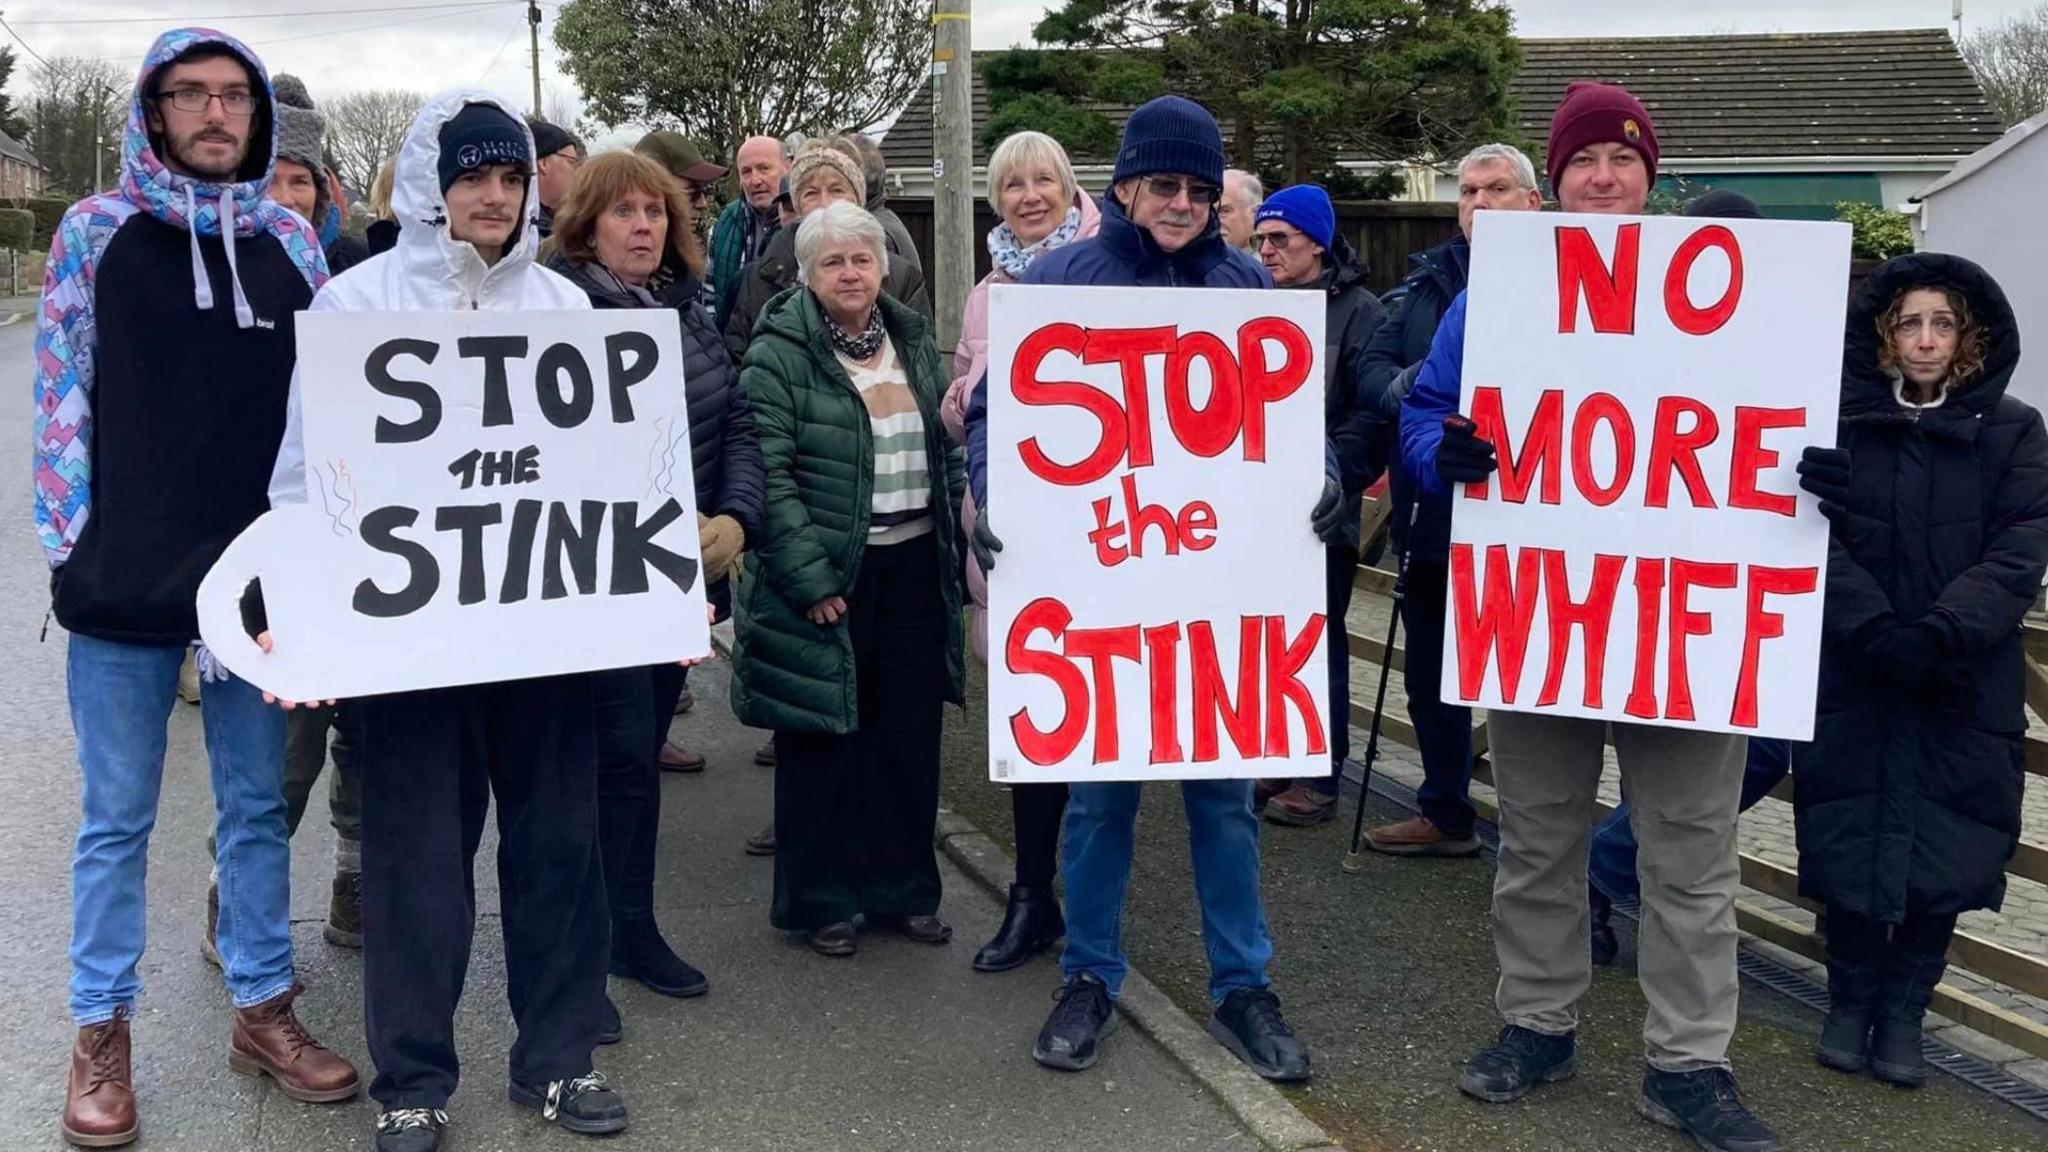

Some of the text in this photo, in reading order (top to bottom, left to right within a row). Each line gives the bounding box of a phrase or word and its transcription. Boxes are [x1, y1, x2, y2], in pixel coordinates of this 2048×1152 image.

[1555, 224, 1743, 336] NO
[365, 331, 659, 443] STOP
[1010, 316, 1313, 486] STOP
[448, 446, 541, 489] THE
[1463, 387, 1806, 517] MORE
[353, 498, 698, 617] STINK
[1088, 473, 1218, 567] the
[1005, 597, 1328, 766] STINK
[1450, 543, 1818, 728] WHIFF
